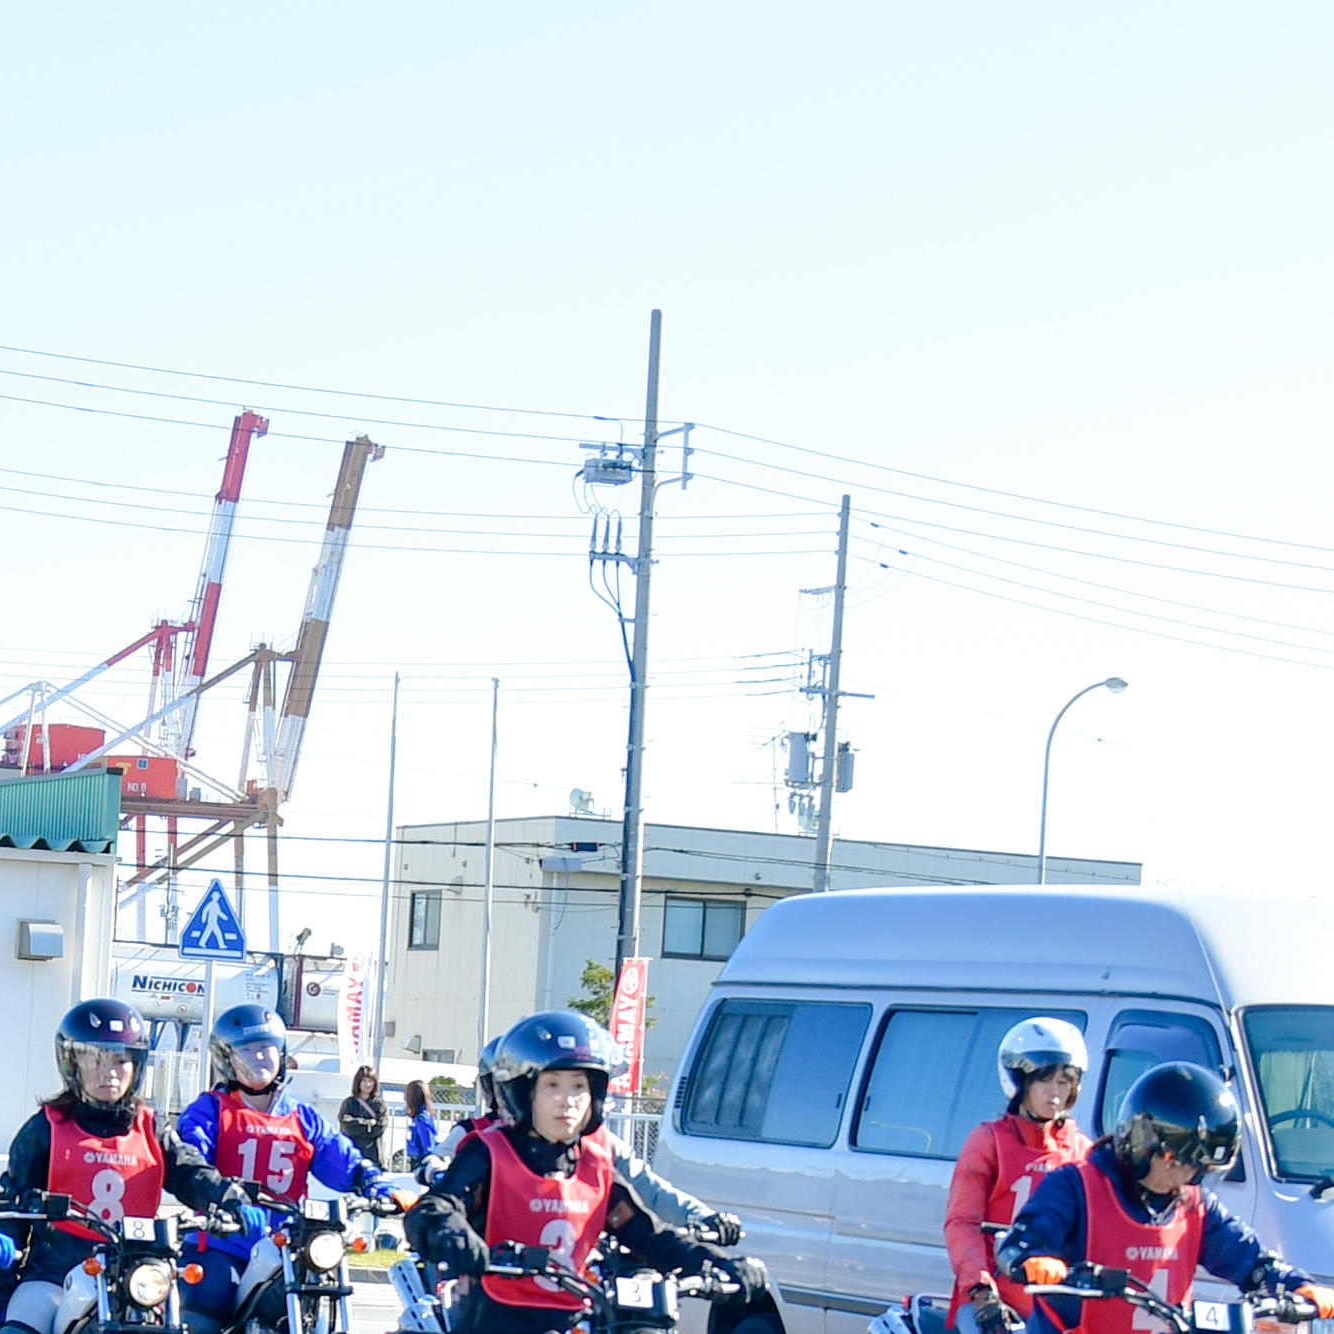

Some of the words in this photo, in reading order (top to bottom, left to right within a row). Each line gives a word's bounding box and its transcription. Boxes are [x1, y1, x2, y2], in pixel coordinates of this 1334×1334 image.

[131, 974, 205, 994] NICHICON
[255, 1124, 292, 1136] YAMAHA
[95, 1151, 138, 1166] YAMAHA
[238, 1138, 297, 1194] 15
[87, 1168, 125, 1228] 8
[543, 1199, 589, 1213] YAMAHA
[309, 1203, 330, 1218] 15
[133, 1220, 146, 1239] 8
[1139, 1246, 1179, 1260] YAMAHA
[630, 1281, 642, 1302] 3
[1205, 1305, 1220, 1326] 4
